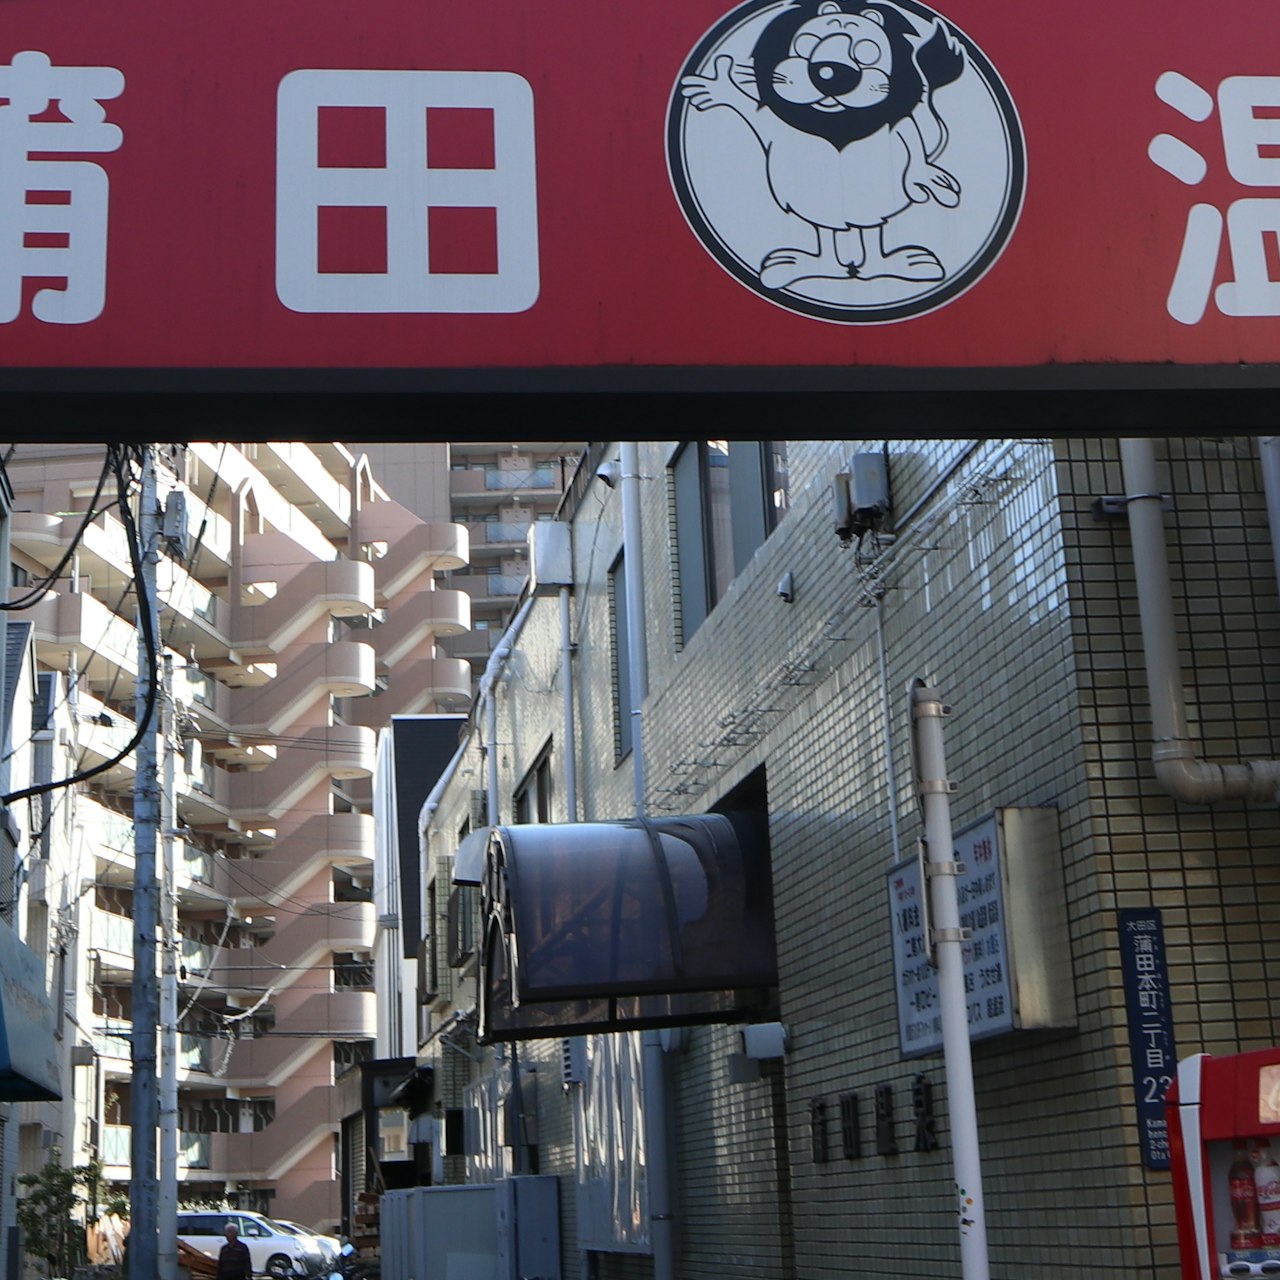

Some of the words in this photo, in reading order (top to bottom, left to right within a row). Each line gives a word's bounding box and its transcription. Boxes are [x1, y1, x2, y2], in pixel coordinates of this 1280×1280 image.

[1126, 920, 1158, 931] 大田区
[1133, 934, 1165, 1068] 蒲田本町二丁目
